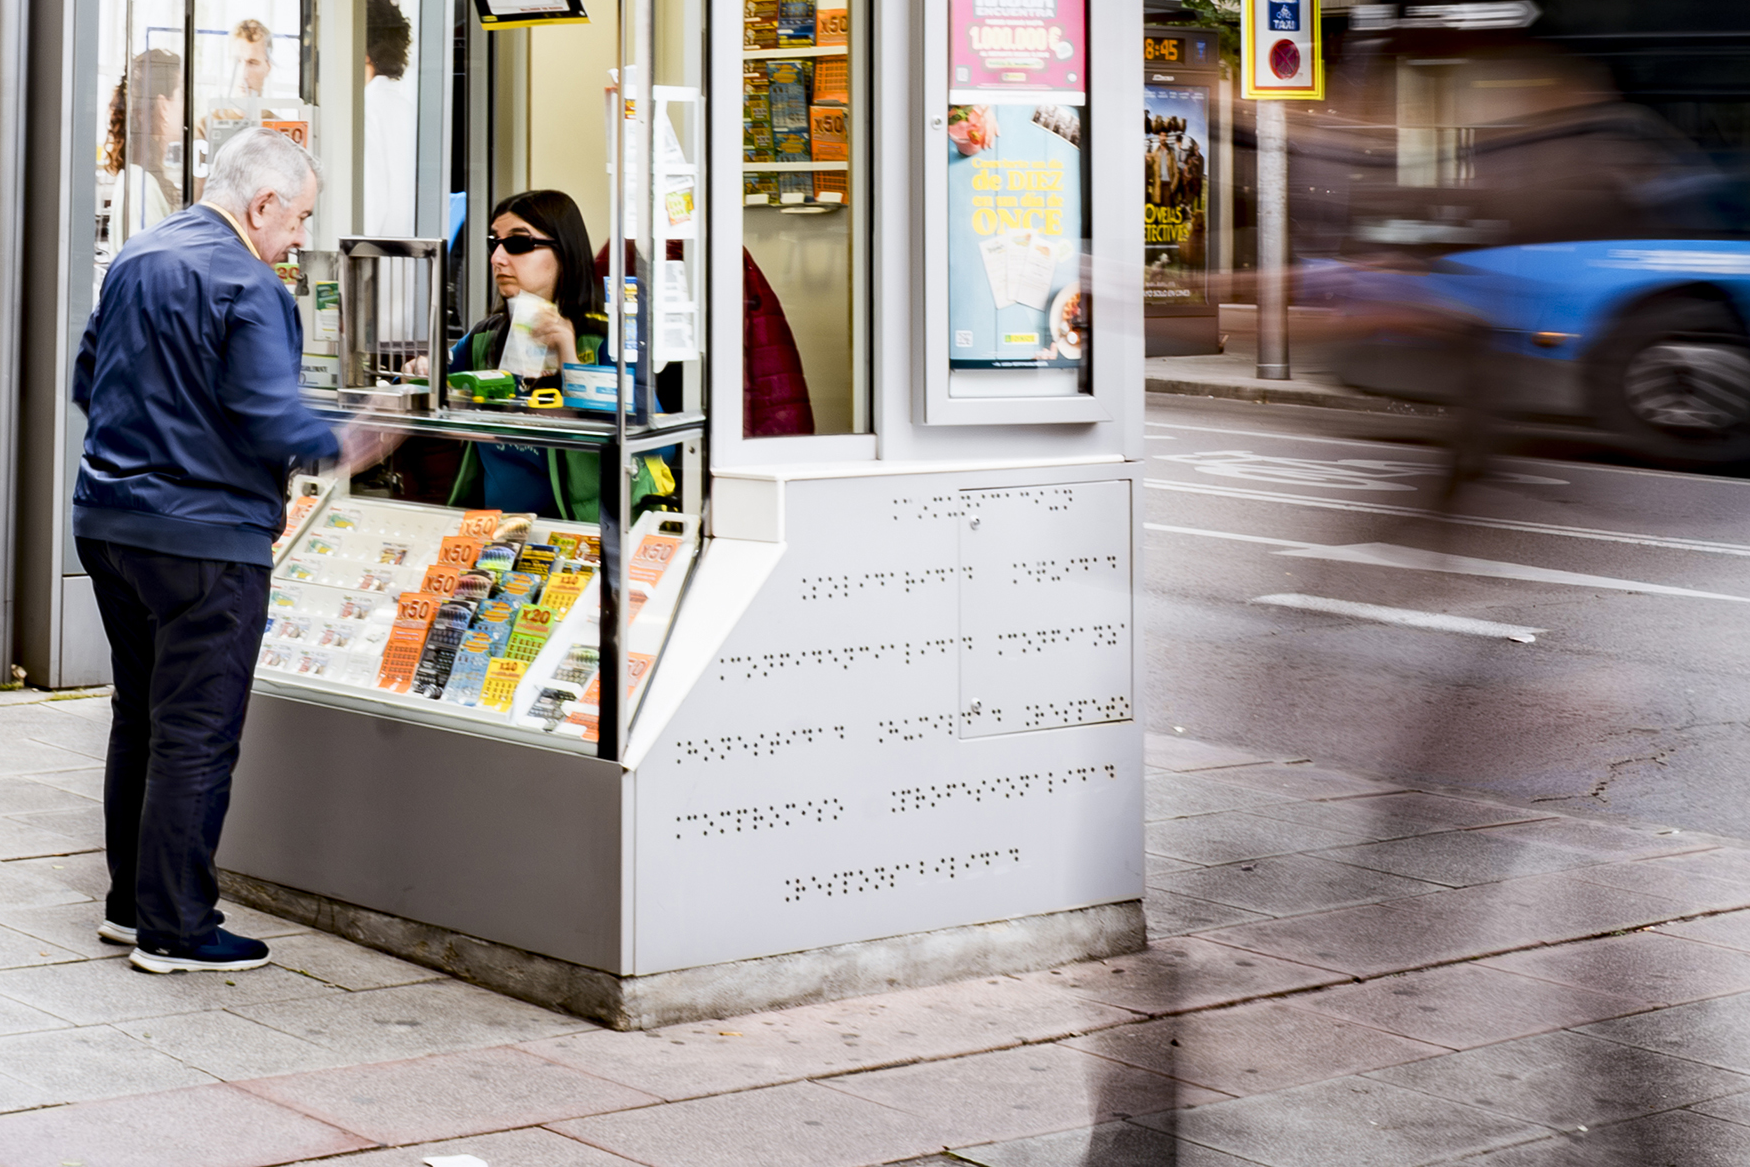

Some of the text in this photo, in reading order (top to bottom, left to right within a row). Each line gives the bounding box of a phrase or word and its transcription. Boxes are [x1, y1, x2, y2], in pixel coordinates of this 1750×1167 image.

[975, 7, 1054, 17] ENCUENTRA
[819, 15, 848, 35] x50
[1272, 20, 1296, 29] TAXI
[969, 26, 1047, 51] 1.000.000
[1144, 38, 1178, 61] 8:45
[814, 115, 844, 134] x50
[1032, 161, 1046, 169] un
[972, 169, 1064, 191] de DIEZ
[972, 195, 993, 207] en
[996, 196, 1017, 207] un
[1047, 193, 1064, 207] de
[972, 208, 1063, 236] ONCE
[277, 267, 299, 279] 20
[464, 517, 495, 537] x50
[440, 544, 473, 564] x50
[638, 542, 674, 562] x50
[426, 573, 456, 593] x50
[399, 600, 430, 620] x50
[521, 608, 551, 624] x20
[499, 662, 518, 672] x10
